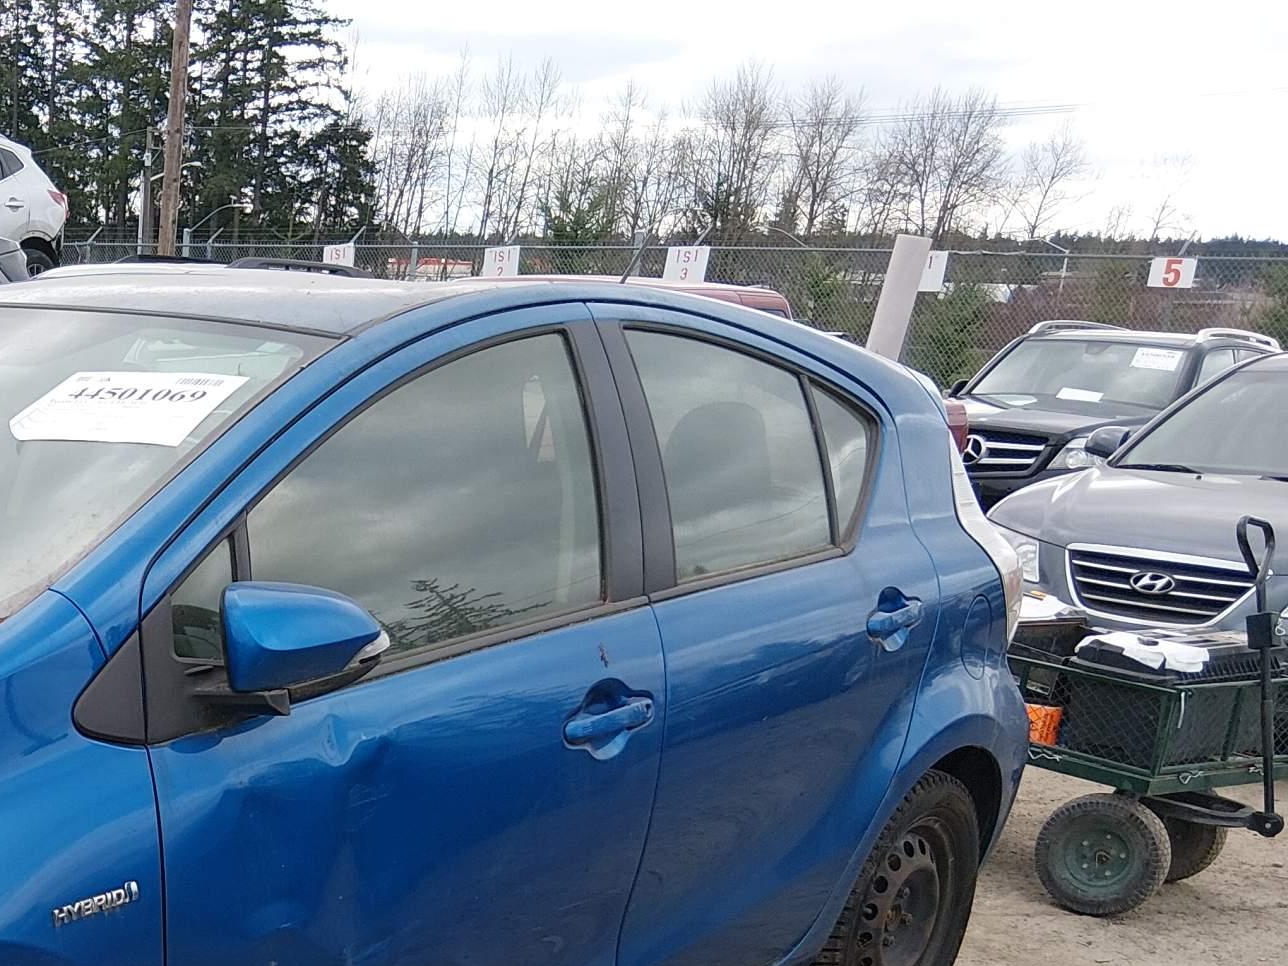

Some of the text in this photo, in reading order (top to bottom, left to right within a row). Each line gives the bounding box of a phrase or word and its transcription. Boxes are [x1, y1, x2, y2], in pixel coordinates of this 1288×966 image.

[680, 267, 688, 280] 3
[1162, 259, 1184, 287] 5
[68, 386, 207, 402] 44501069
[53, 888, 126, 925] HYBRID
